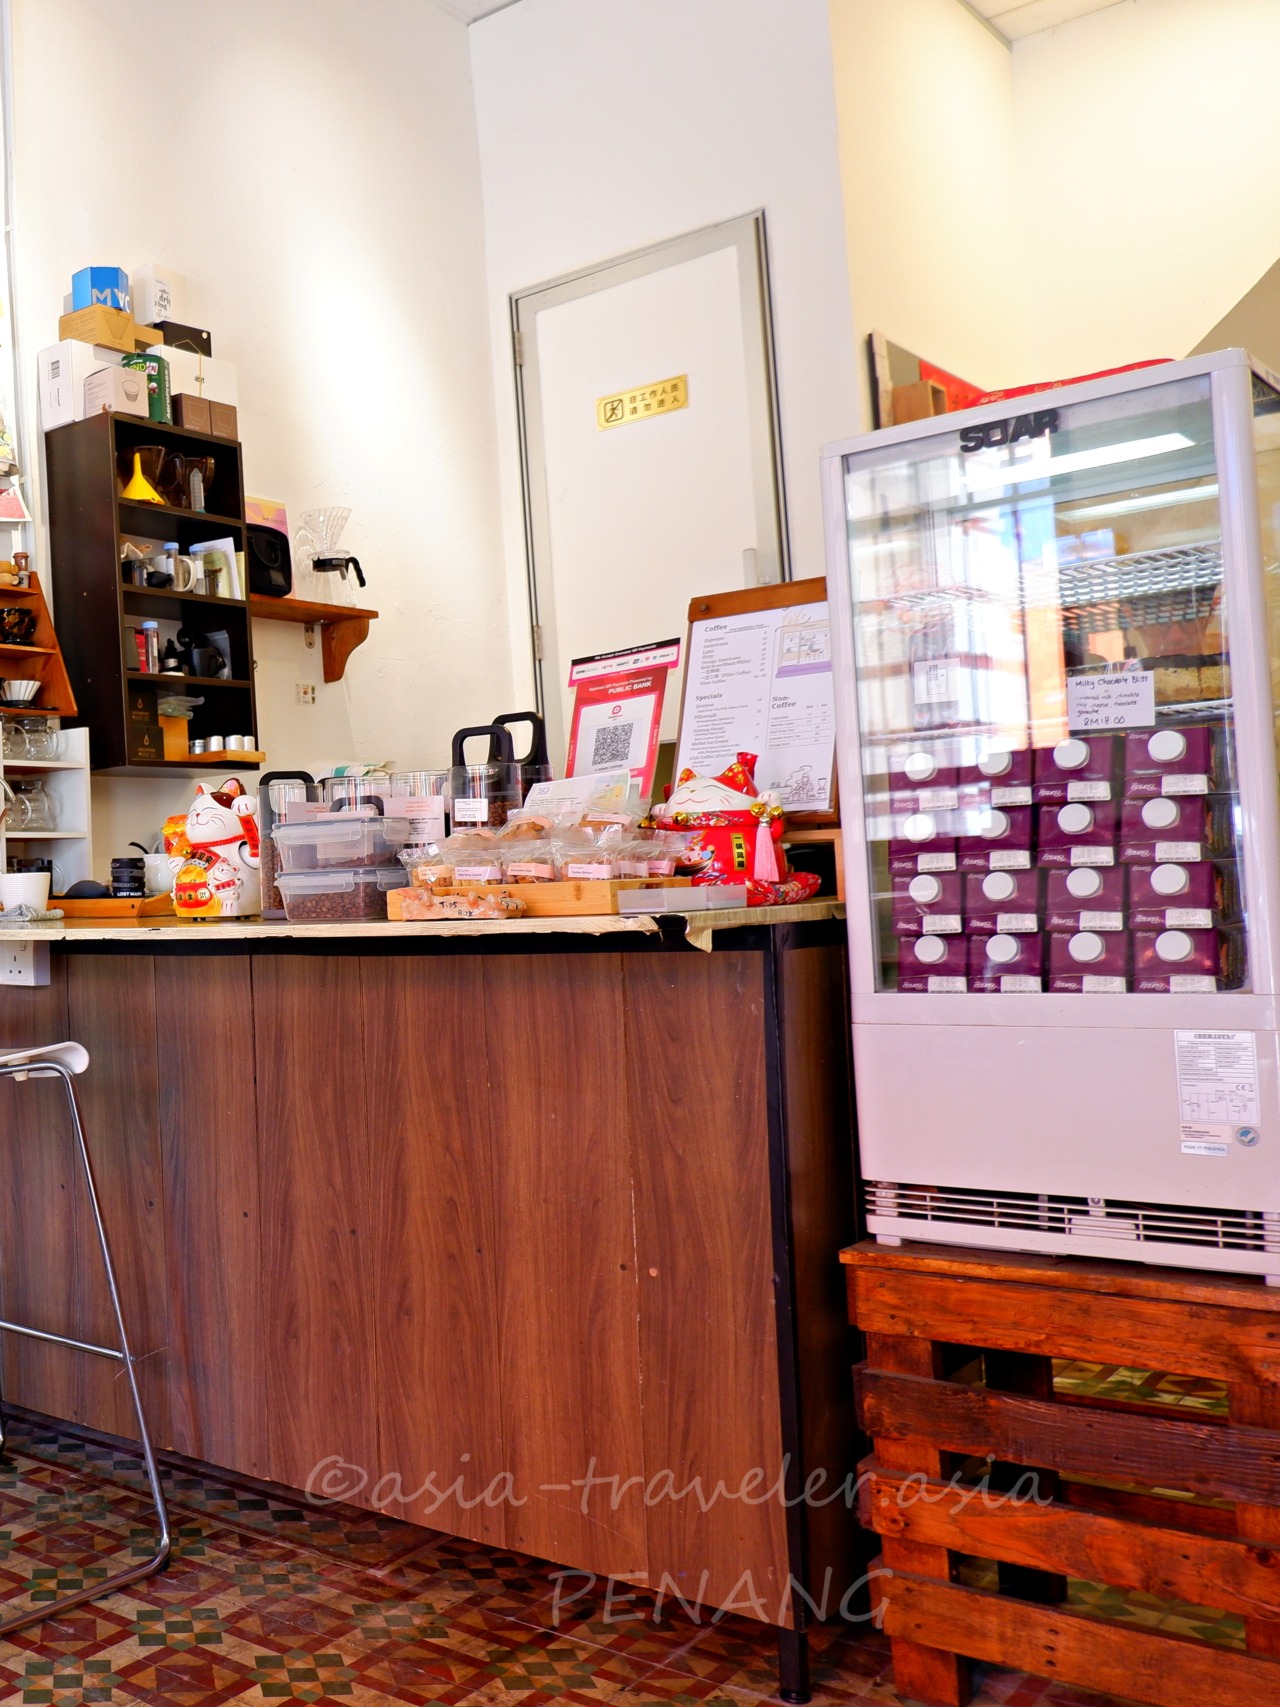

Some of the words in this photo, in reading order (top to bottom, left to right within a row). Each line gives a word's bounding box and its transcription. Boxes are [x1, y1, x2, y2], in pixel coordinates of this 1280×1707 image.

[959, 408, 1059, 453] SOAR
[704, 624, 728, 633] Coffee
[608, 684, 632, 695] PUBLIC
[632, 681, 653, 690] BANK
[695, 693, 723, 702] Specials
[771, 702, 797, 710] Coffee
